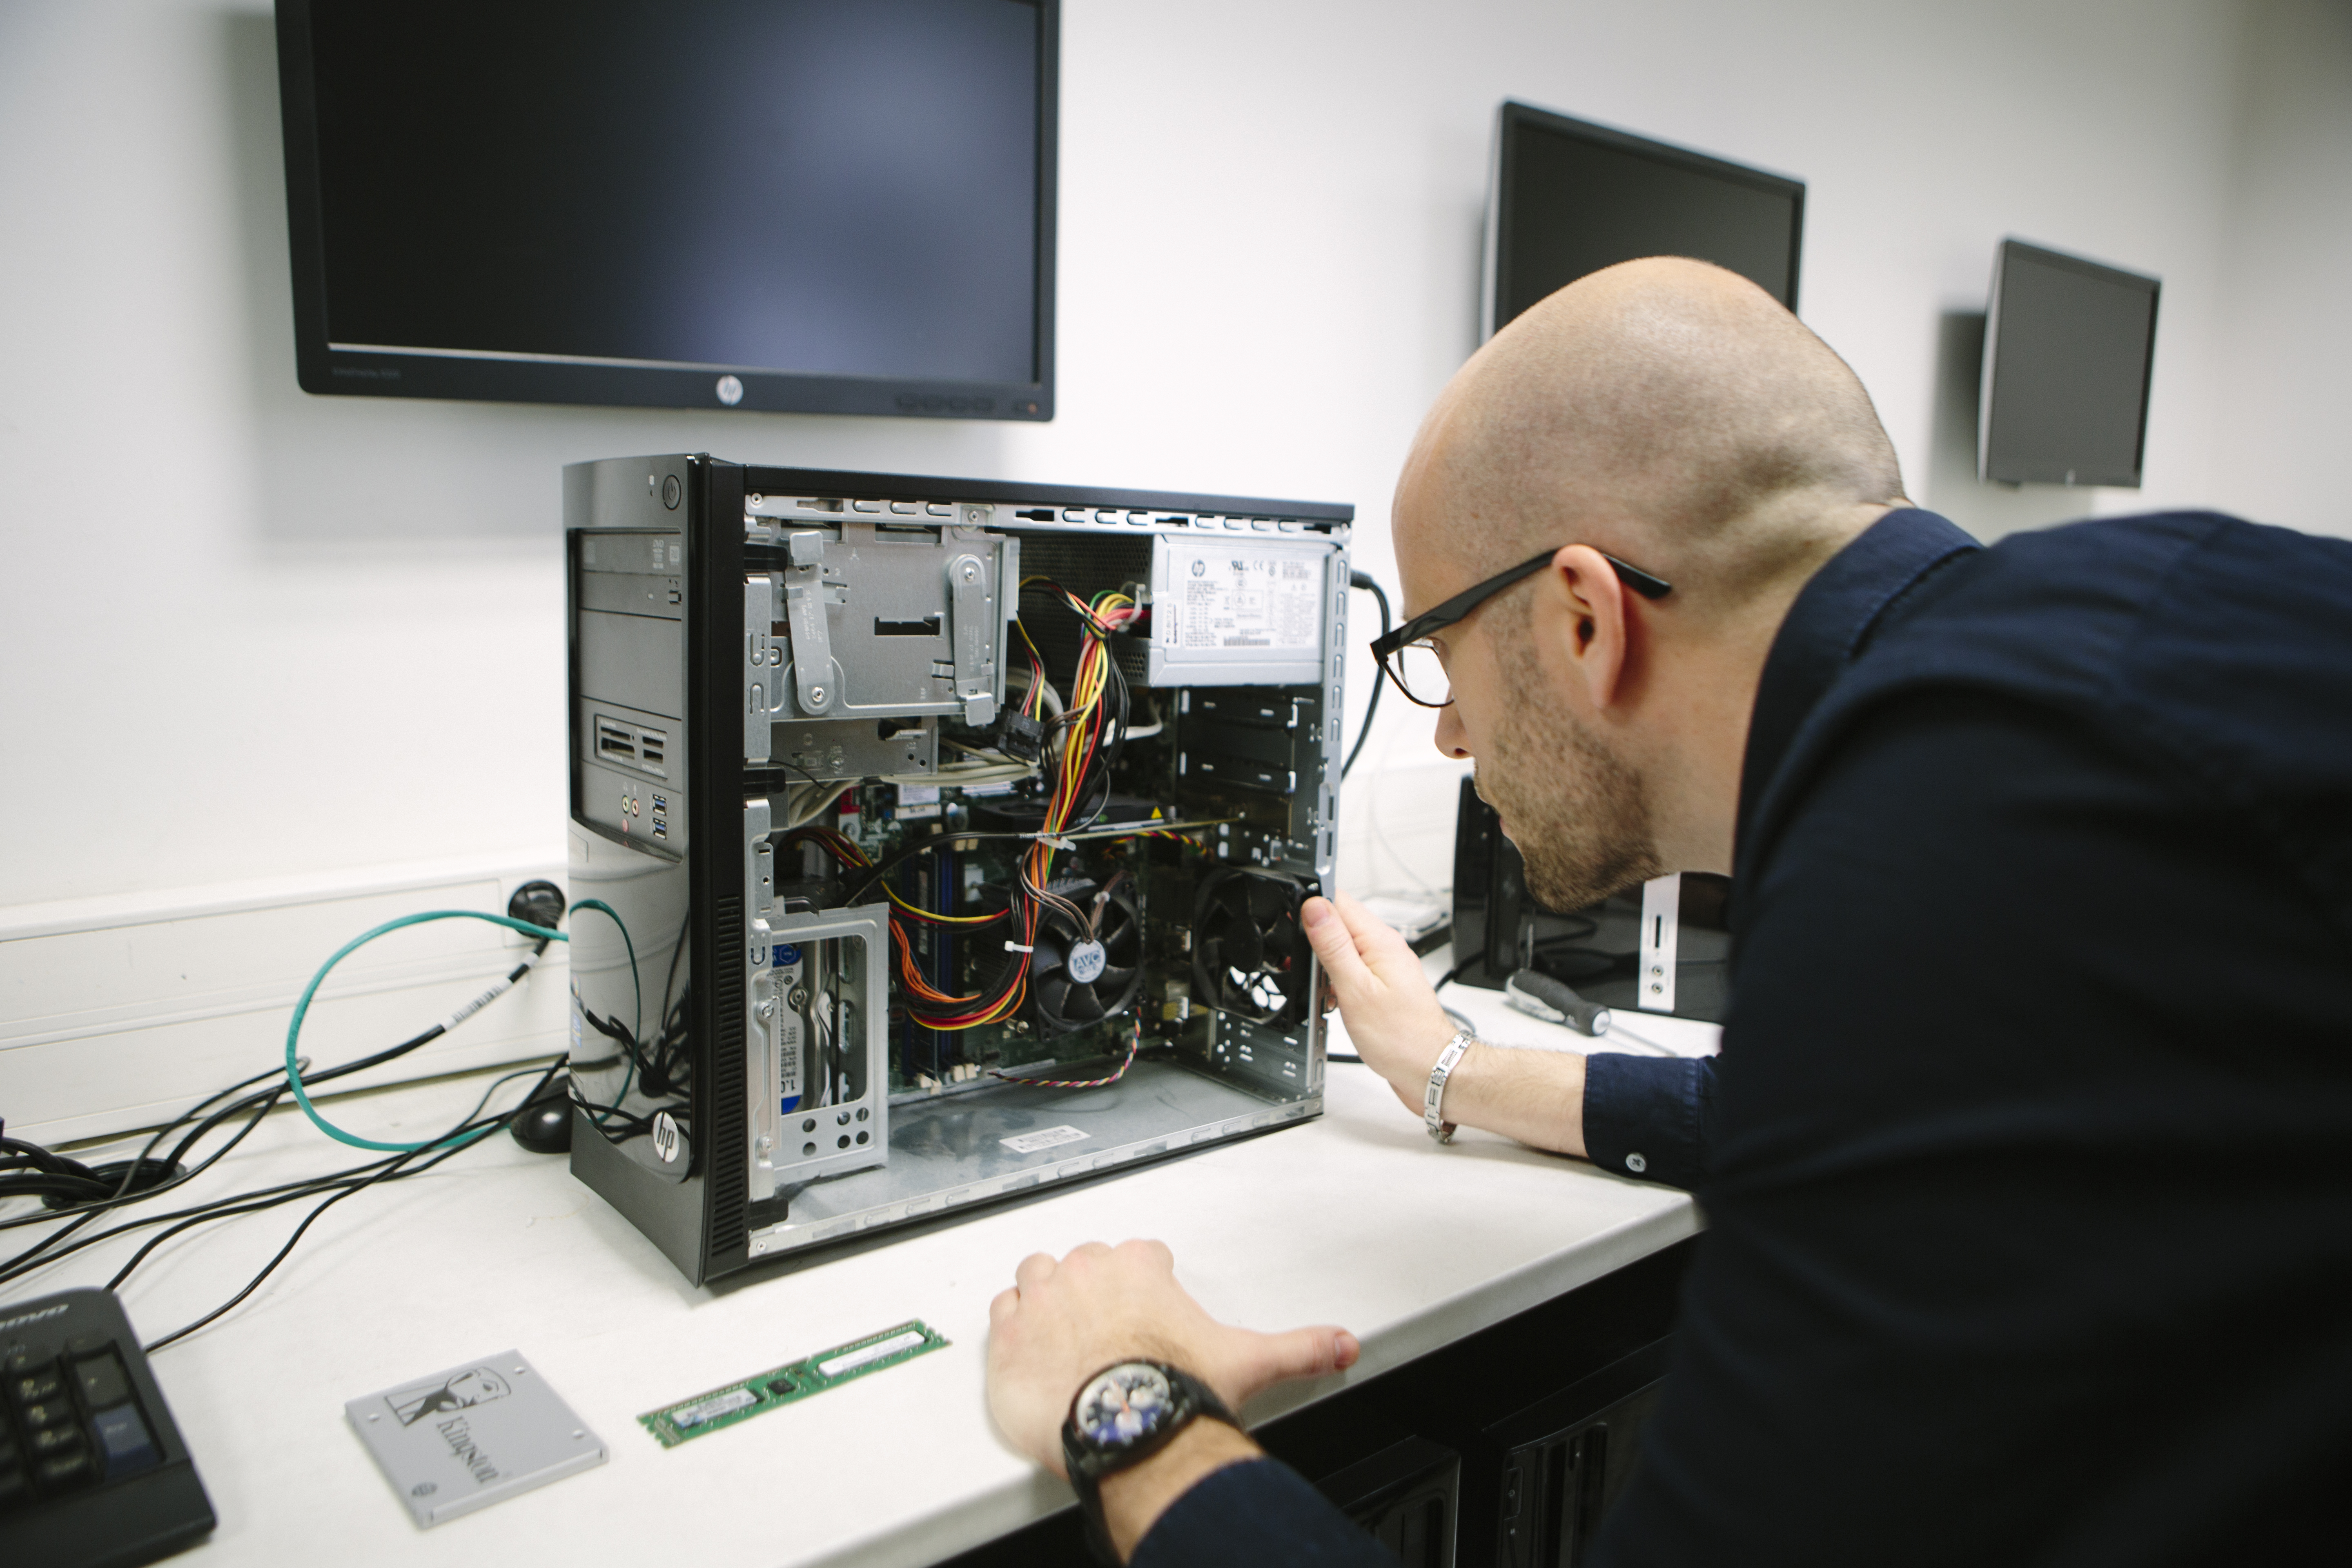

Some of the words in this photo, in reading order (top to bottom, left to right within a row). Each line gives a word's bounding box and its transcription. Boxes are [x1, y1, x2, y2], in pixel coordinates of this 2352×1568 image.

[719, 375, 741, 406] hp
[1074, 951, 1101, 971] AVC
[655, 1111, 677, 1163] hp
[436, 1415, 499, 1483] Kingston
